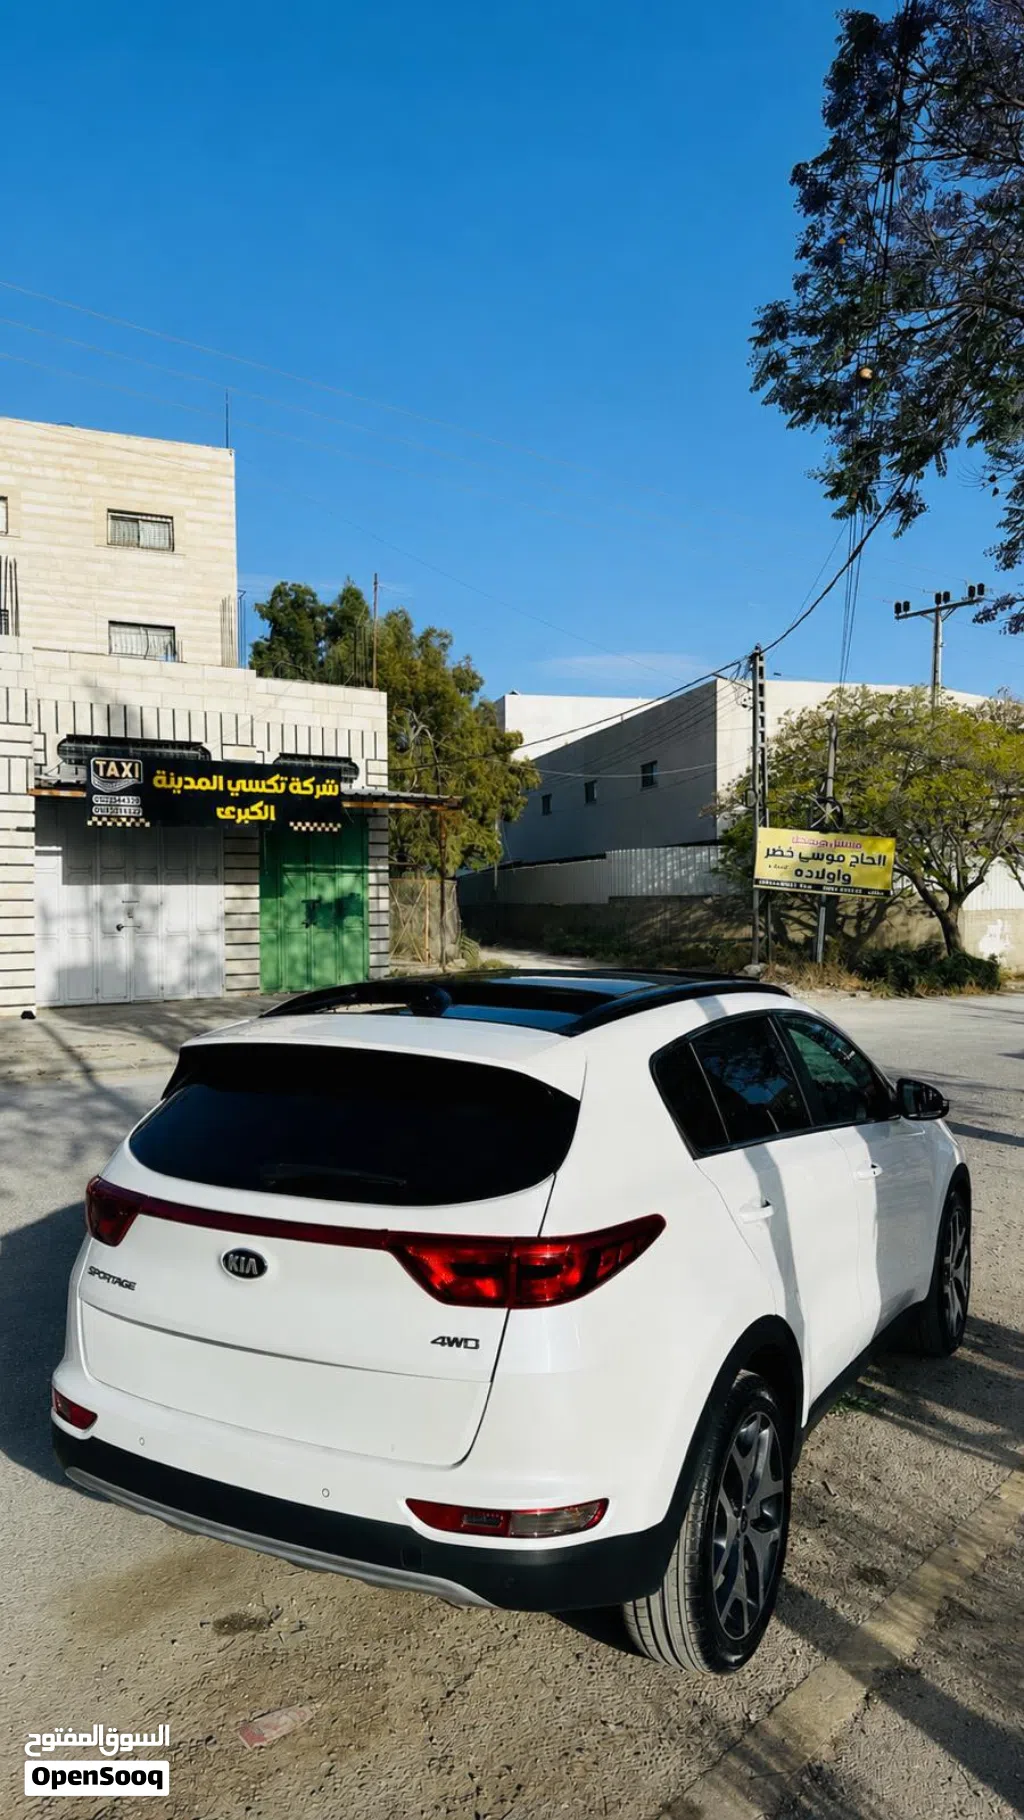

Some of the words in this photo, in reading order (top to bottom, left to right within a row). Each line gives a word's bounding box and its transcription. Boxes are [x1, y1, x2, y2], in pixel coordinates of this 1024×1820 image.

[95, 760, 140, 779] TAXI
[152, 769, 224, 795] المدينة
[227, 773, 288, 797] تكسي
[288, 776, 340, 799] شركة
[216, 800, 277, 824] الكبرى
[764, 845, 794, 859] خضر
[849, 852, 887, 868] الحاج
[227, 1254, 259, 1275] KIA
[88, 1265, 137, 1291] SPORTAGE
[430, 1336, 480, 1349] 4WD
